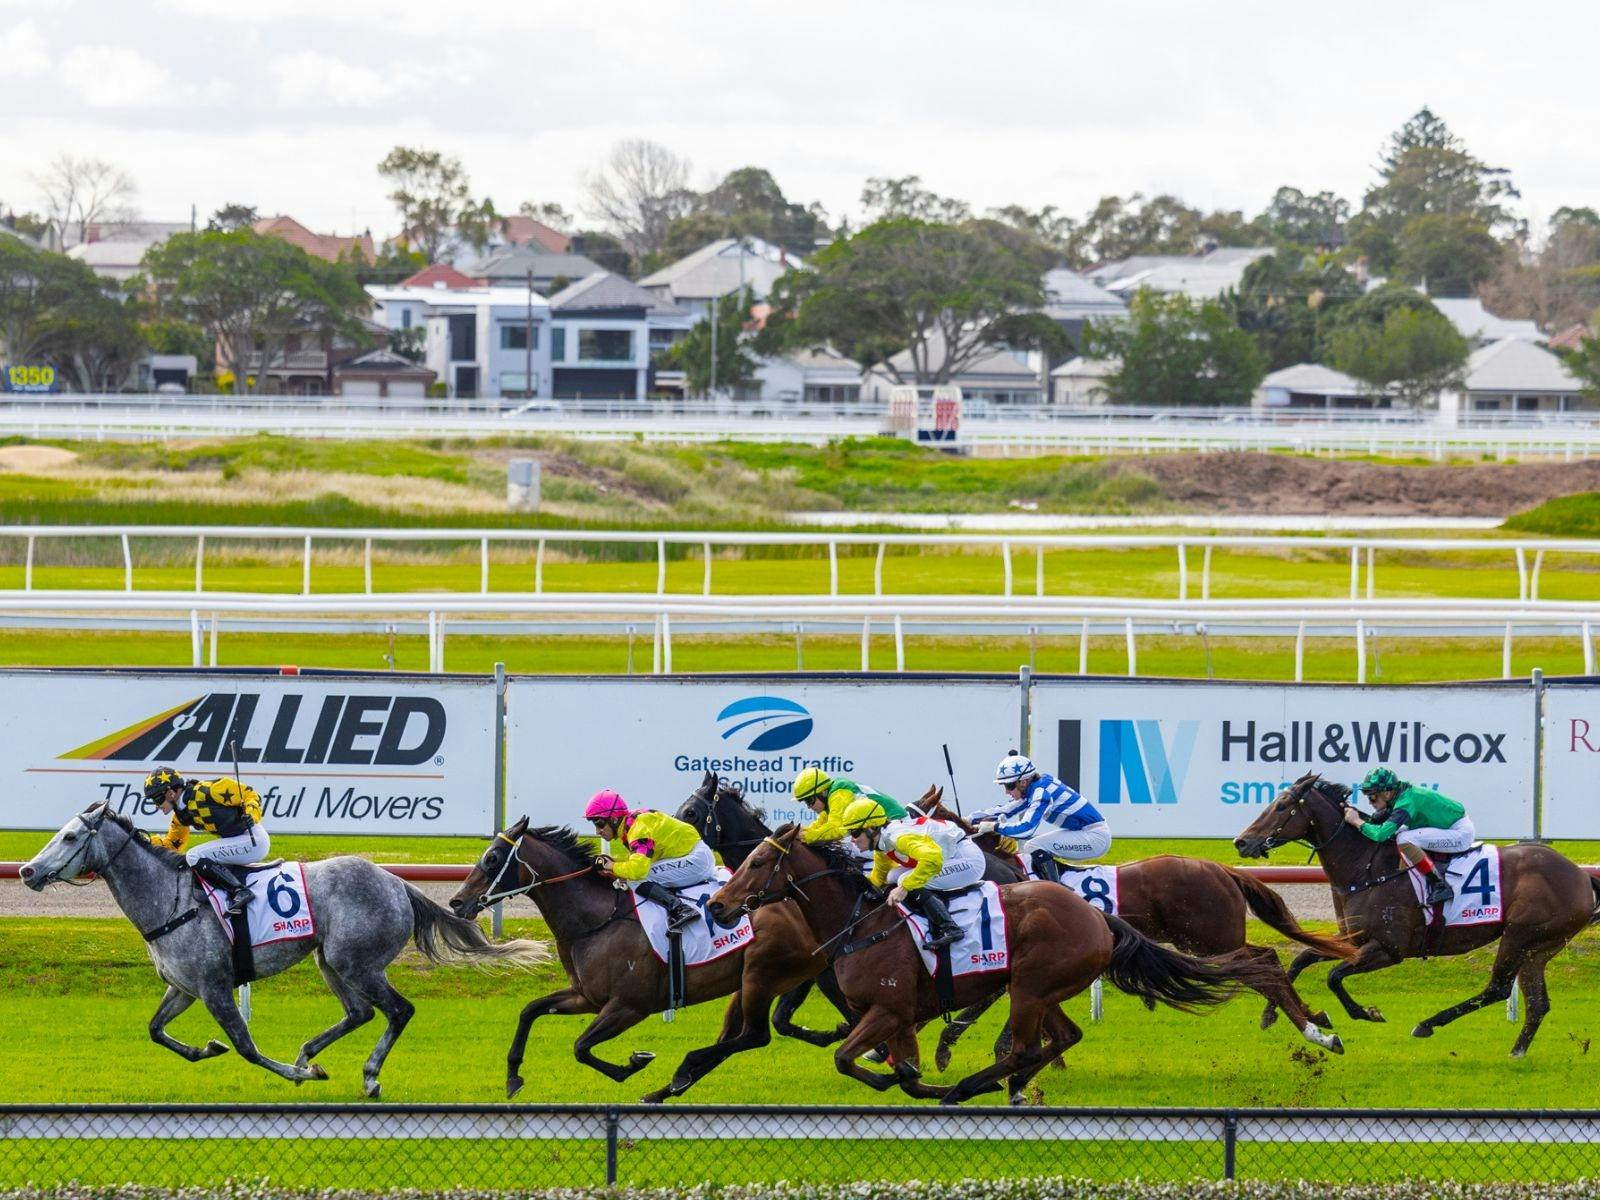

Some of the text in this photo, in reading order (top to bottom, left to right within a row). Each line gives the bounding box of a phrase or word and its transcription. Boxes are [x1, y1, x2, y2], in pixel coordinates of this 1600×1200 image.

[9, 365, 54, 386] 1350
[152, 693, 447, 765] ALLIED
[1221, 720, 1507, 764] Hall&Wilcox
[674, 755, 854, 772] Gateshead Traffic
[315, 787, 443, 820] Movers
[774, 808, 796, 821] the
[1053, 843, 1092, 851] CHAMBERS
[267, 871, 300, 918] 6
[1081, 876, 1113, 914] 8
[1461, 858, 1495, 905] 4
[272, 918, 310, 932] SHARP
[980, 897, 993, 950] 1
[1461, 908, 1499, 918] SHARP
[713, 925, 750, 949] SHARP
